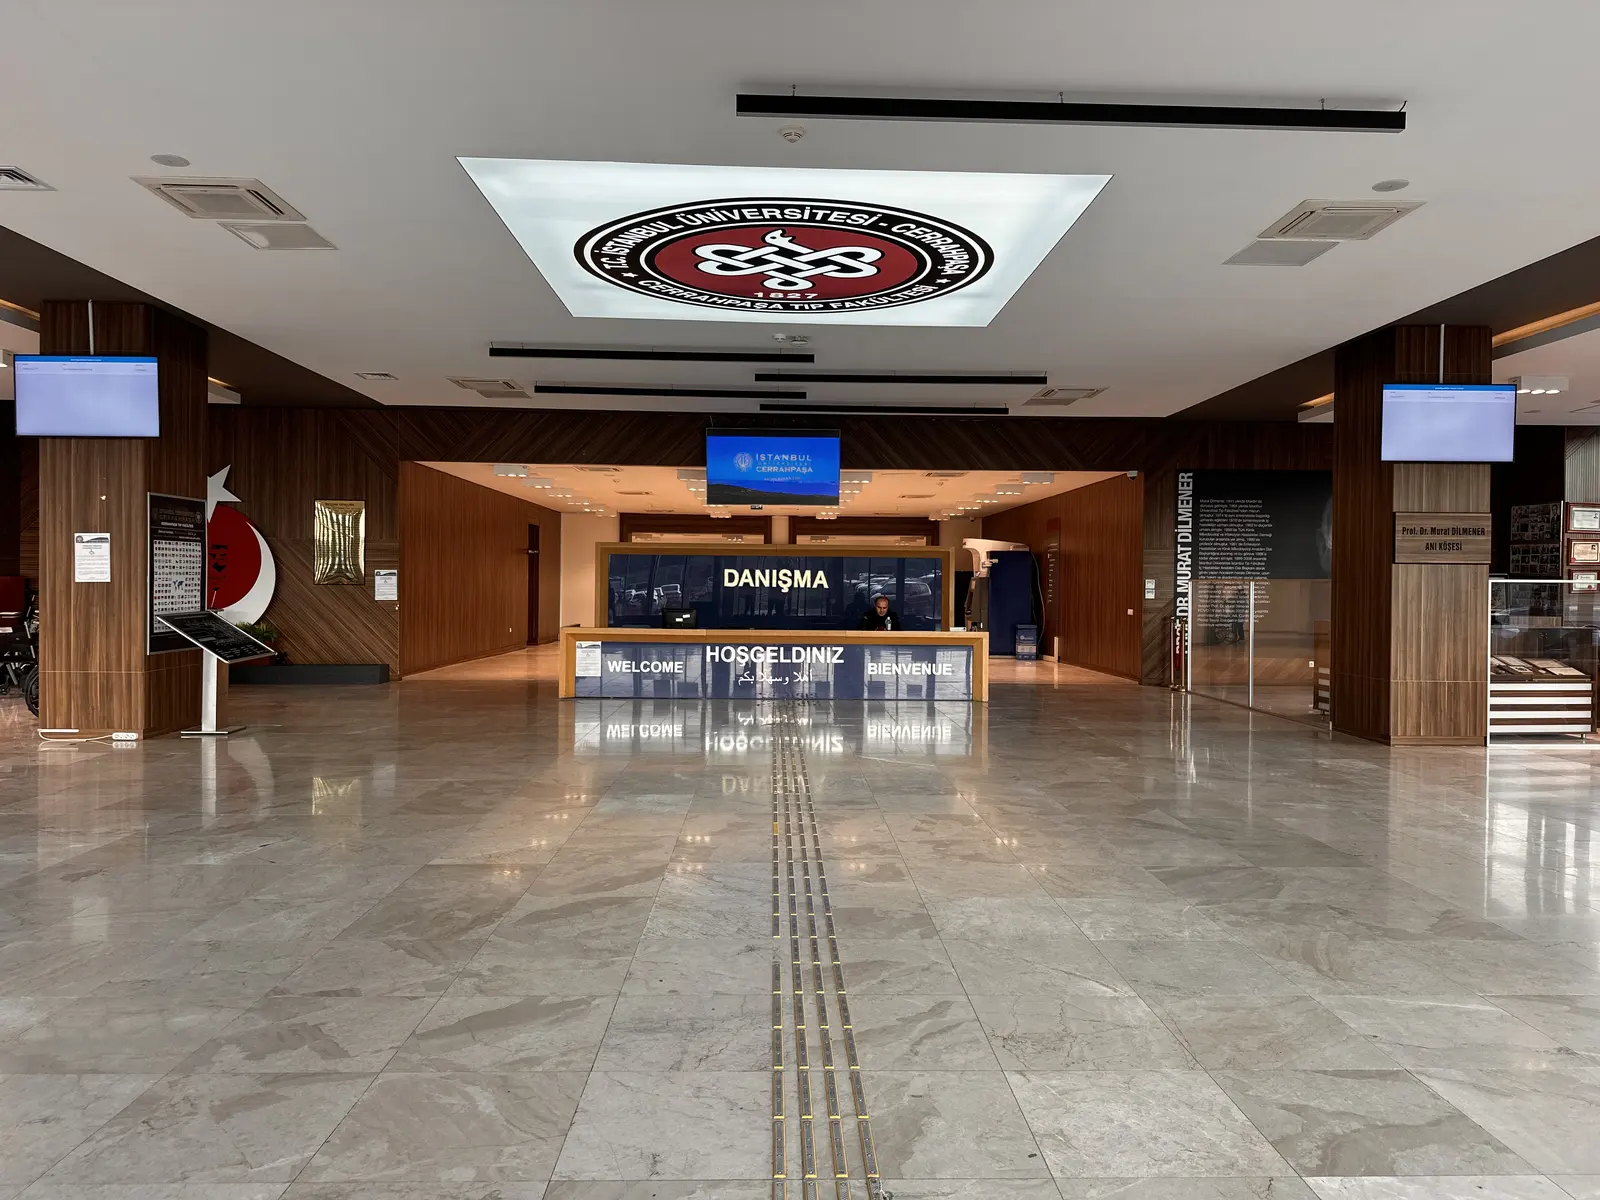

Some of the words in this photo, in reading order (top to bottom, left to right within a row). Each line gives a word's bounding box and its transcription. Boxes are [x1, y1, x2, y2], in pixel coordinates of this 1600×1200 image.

[594, 221, 684, 255] İSTANBUL
[675, 207, 882, 226] ÜNİVERSİTESİ
[891, 223, 970, 275] CERRAHPAŞA
[638, 280, 783, 309] CERRAHPAŞA
[830, 284, 938, 309] FAKÜLTESİ
[754, 291, 818, 299] 1827
[756, 465, 813, 475] CERRAHPAŞA
[1174, 472, 1193, 542] DİLMENER
[1431, 526, 1450, 535] Murat
[1451, 525, 1486, 536] DİLMENER
[1425, 542, 1437, 551] ANI
[1438, 540, 1463, 552] KÖŞESİ
[1176, 544, 1192, 592] MURAT
[723, 568, 829, 593] DANIŞMA
[607, 660, 684, 673] WELCOME
[867, 662, 952, 676] BIENVENUE
[738, 671, 755, 686] بكم
